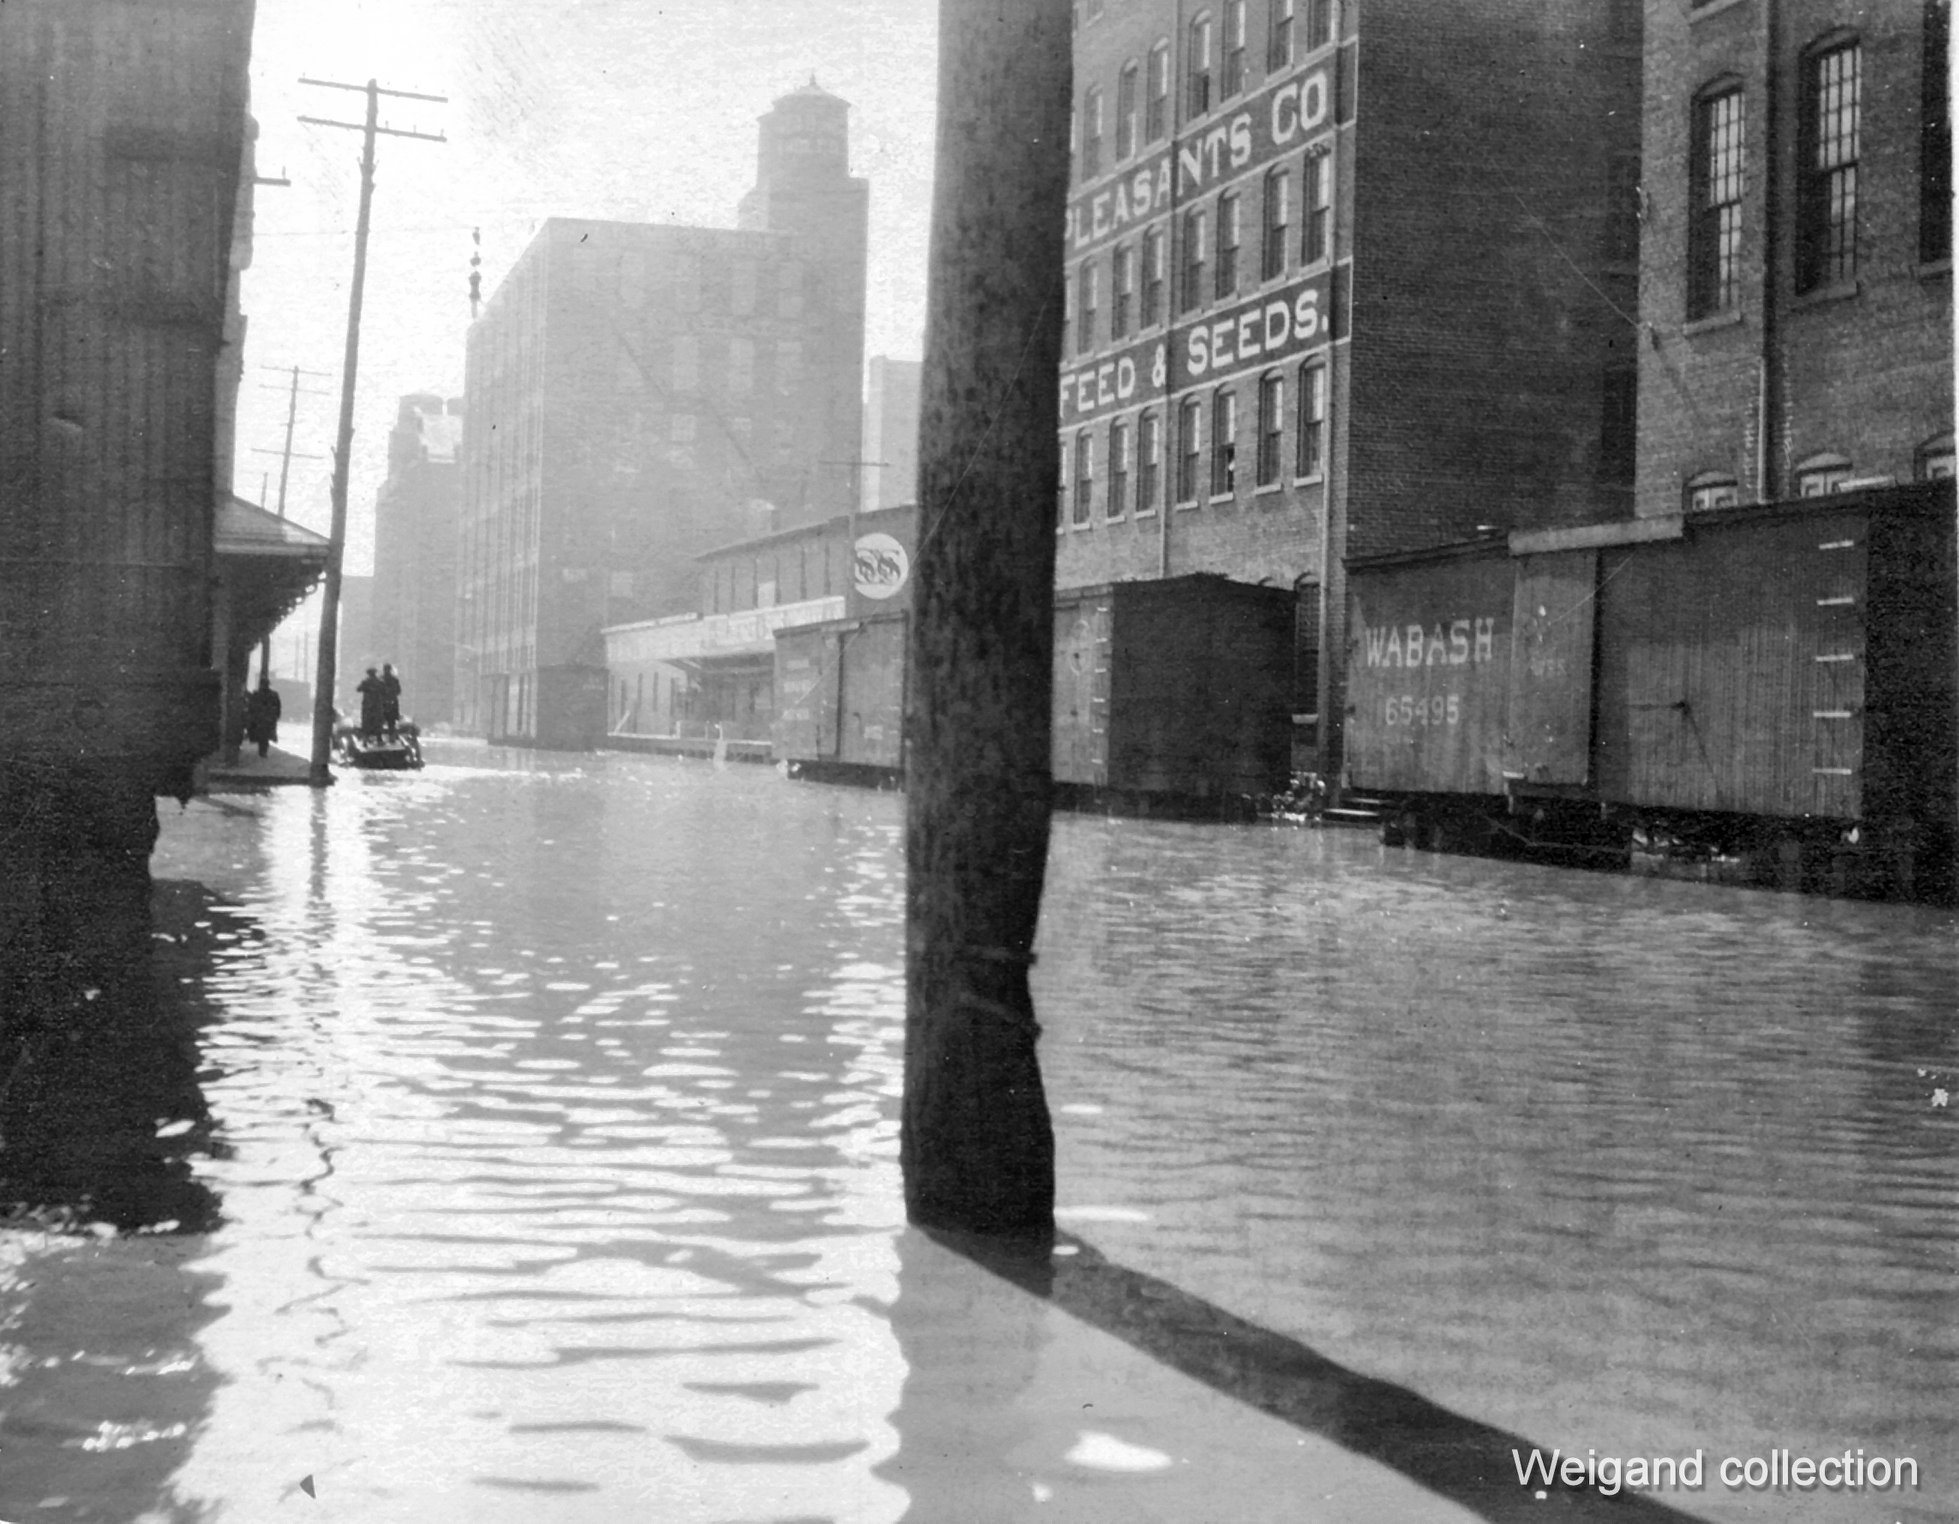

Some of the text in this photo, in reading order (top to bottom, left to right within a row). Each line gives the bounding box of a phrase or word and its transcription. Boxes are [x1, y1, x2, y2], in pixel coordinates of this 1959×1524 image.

[1271, 69, 1327, 145] CO
[1060, 289, 1329, 418] FEED & SEEDS.
[1365, 617, 1495, 667] WABASH
[1385, 693, 1460, 726] 65495
